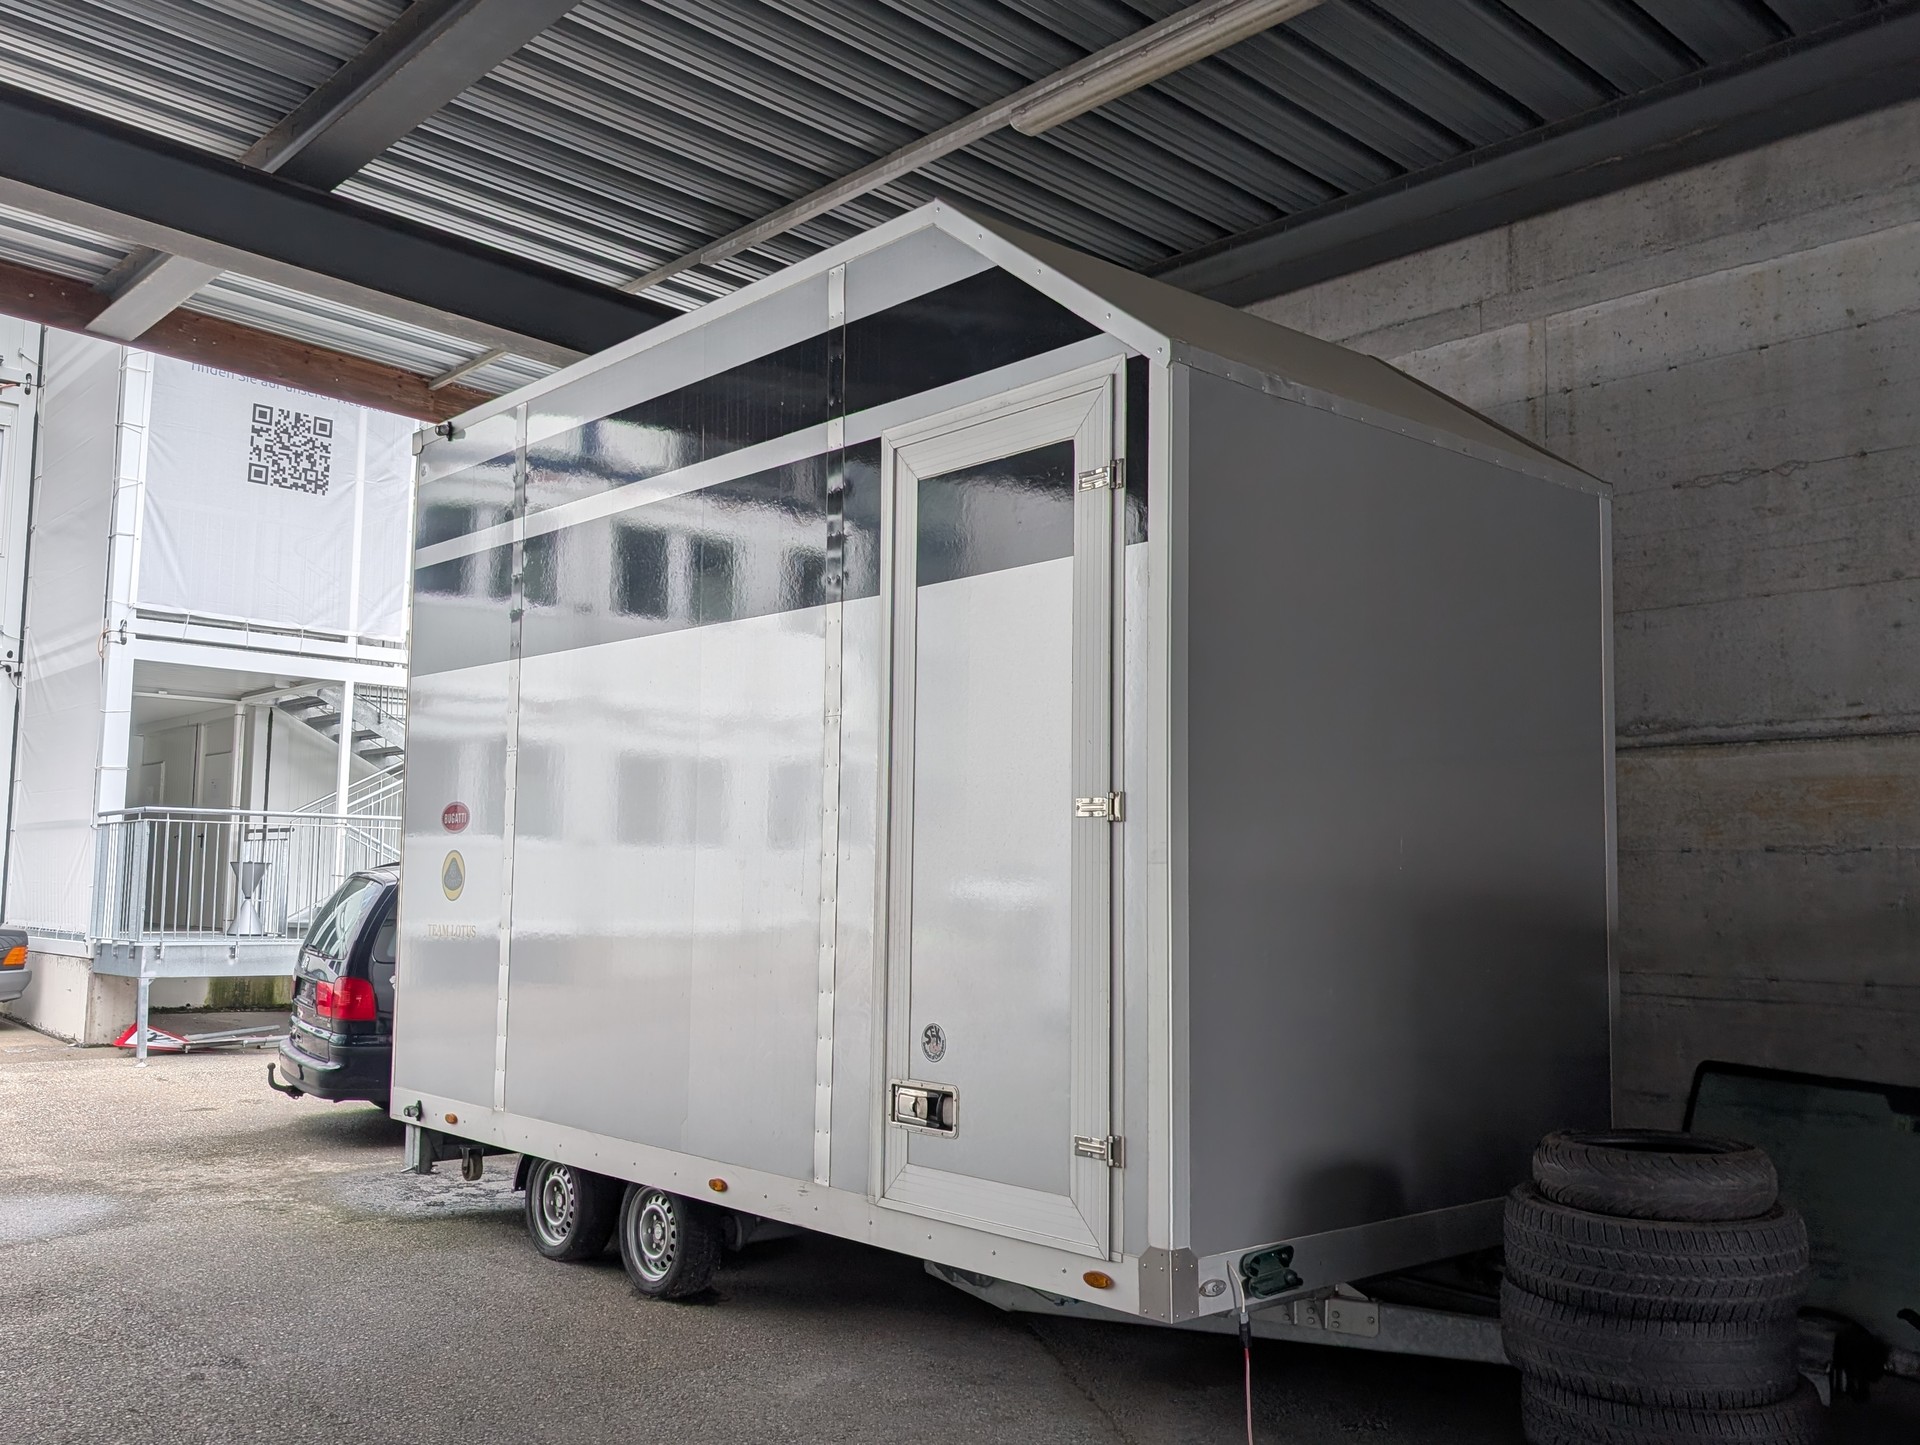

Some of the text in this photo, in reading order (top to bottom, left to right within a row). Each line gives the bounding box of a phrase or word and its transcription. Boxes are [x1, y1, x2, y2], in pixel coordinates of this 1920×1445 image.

[444, 812, 467, 825] BUGATTI
[428, 923, 476, 938] TEAM LOTUS
